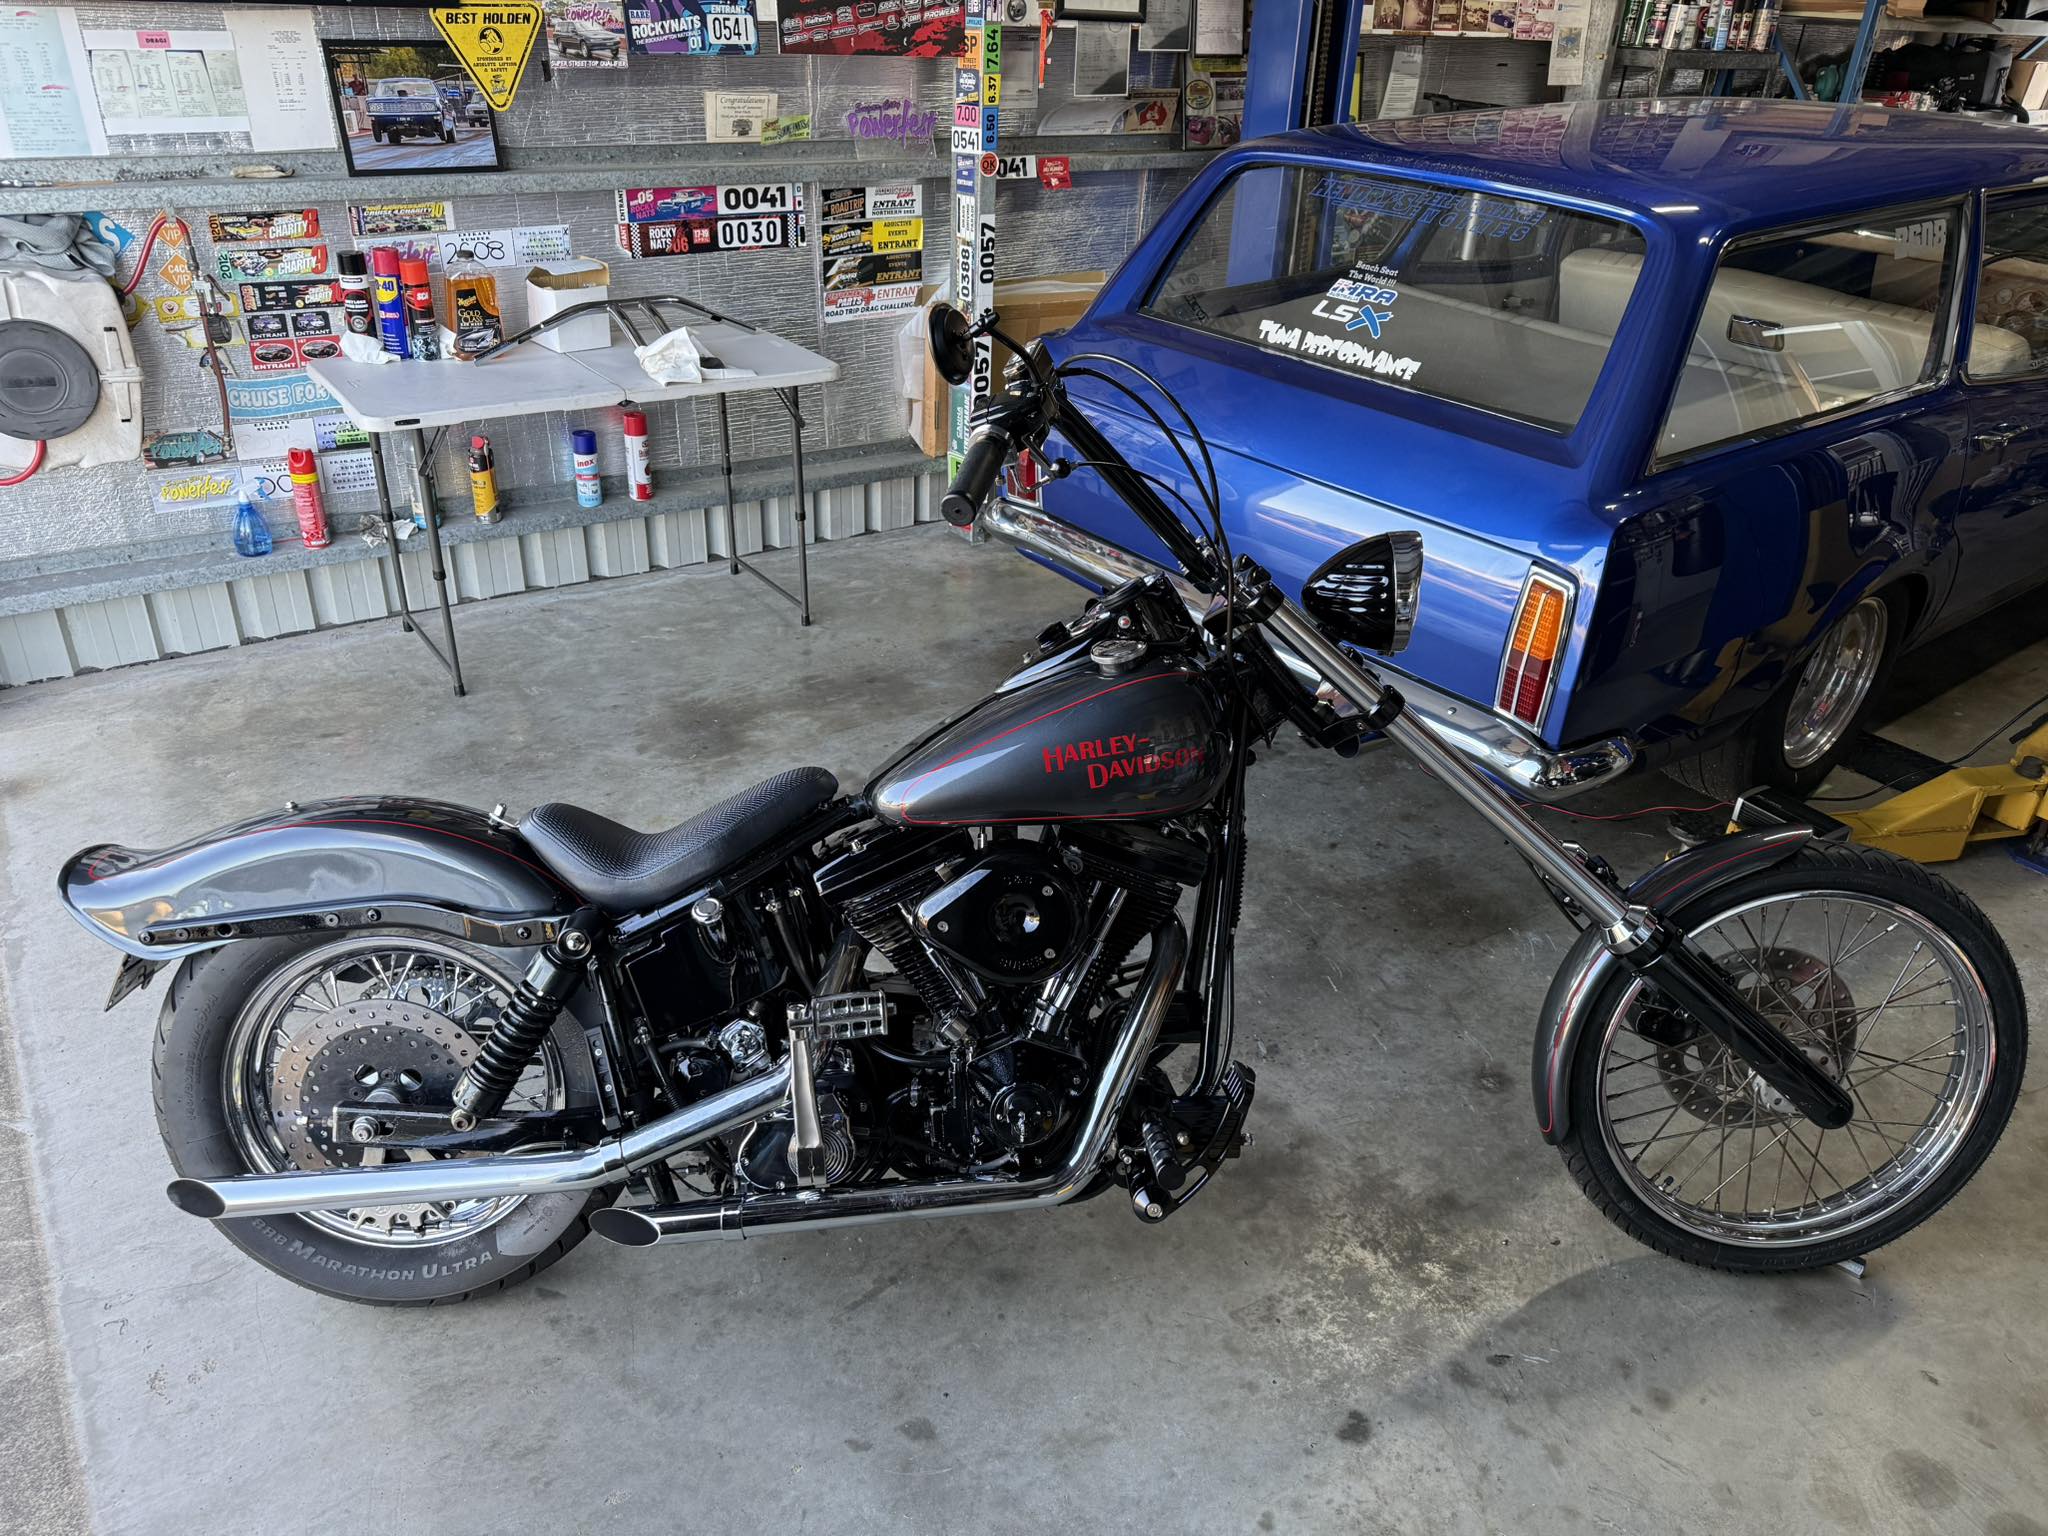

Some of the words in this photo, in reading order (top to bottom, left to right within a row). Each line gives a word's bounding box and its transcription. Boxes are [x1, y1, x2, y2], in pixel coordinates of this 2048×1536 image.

[446, 12, 478, 24] BEST
[483, 12, 532, 24] HOLDEN
[710, 5, 746, 14] ENTRANT
[925, 8, 960, 21] PROWEAR
[631, 14, 702, 39] ROCKYNATS
[712, 16, 749, 42] 0541
[690, 36, 703, 49] 01
[986, 28, 998, 69] 7.64
[956, 105, 977, 122] 7.00
[986, 114, 996, 144] 6.50
[953, 130, 979, 151] 0541
[982, 160, 996, 169] OK
[619, 190, 627, 221] ENTRANT
[637, 190, 654, 204] 05
[724, 186, 787, 211] 0041
[872, 199, 916, 208] ENTRANT
[630, 203, 654, 214] ROCKY
[636, 210, 656, 220] NATS
[162, 228, 180, 240] VIP
[269, 220, 308, 239] CHARITY
[620, 225, 629, 249] TRANT
[650, 228, 677, 239] ROCKY
[722, 221, 779, 246] 0030
[650, 238, 673, 250] NATS
[672, 237, 689, 252] 06
[877, 239, 918, 249] ENTRANT
[980, 222, 995, 285] 0057
[219, 250, 232, 279] 2012
[278, 255, 317, 274] CHARITY
[961, 247, 970, 298] 0388
[1355, 260, 1381, 273] Bench
[1380, 265, 1399, 277] Seat
[172, 274, 190, 285] VIP
[875, 269, 921, 281] ENTRANT
[1349, 269, 1364, 280] The
[1364, 272, 1387, 286] World
[458, 309, 481, 317] GOLD
[825, 309, 845, 318] ROAD
[845, 306, 860, 315] TRIP
[860, 304, 880, 313] DRAG
[880, 301, 914, 310] CHALLENG
[1312, 299, 1394, 340] LSX
[251, 332, 288, 340] ENTRANT
[295, 329, 330, 338] ENTRANT
[1258, 319, 1302, 349] TUNA
[1301, 330, 1422, 381] PERFORMANCE
[254, 362, 297, 371] ENTRANT
[229, 386, 291, 408] CRUISE
[576, 458, 596, 468] inox
[160, 475, 234, 503] Powerfest
[1042, 733, 1150, 774] HARLEY-
[1087, 746, 1205, 790] DAVIDSON
[288, 1238, 416, 1282] MARATHON
[421, 1250, 494, 1279] ULTRA
